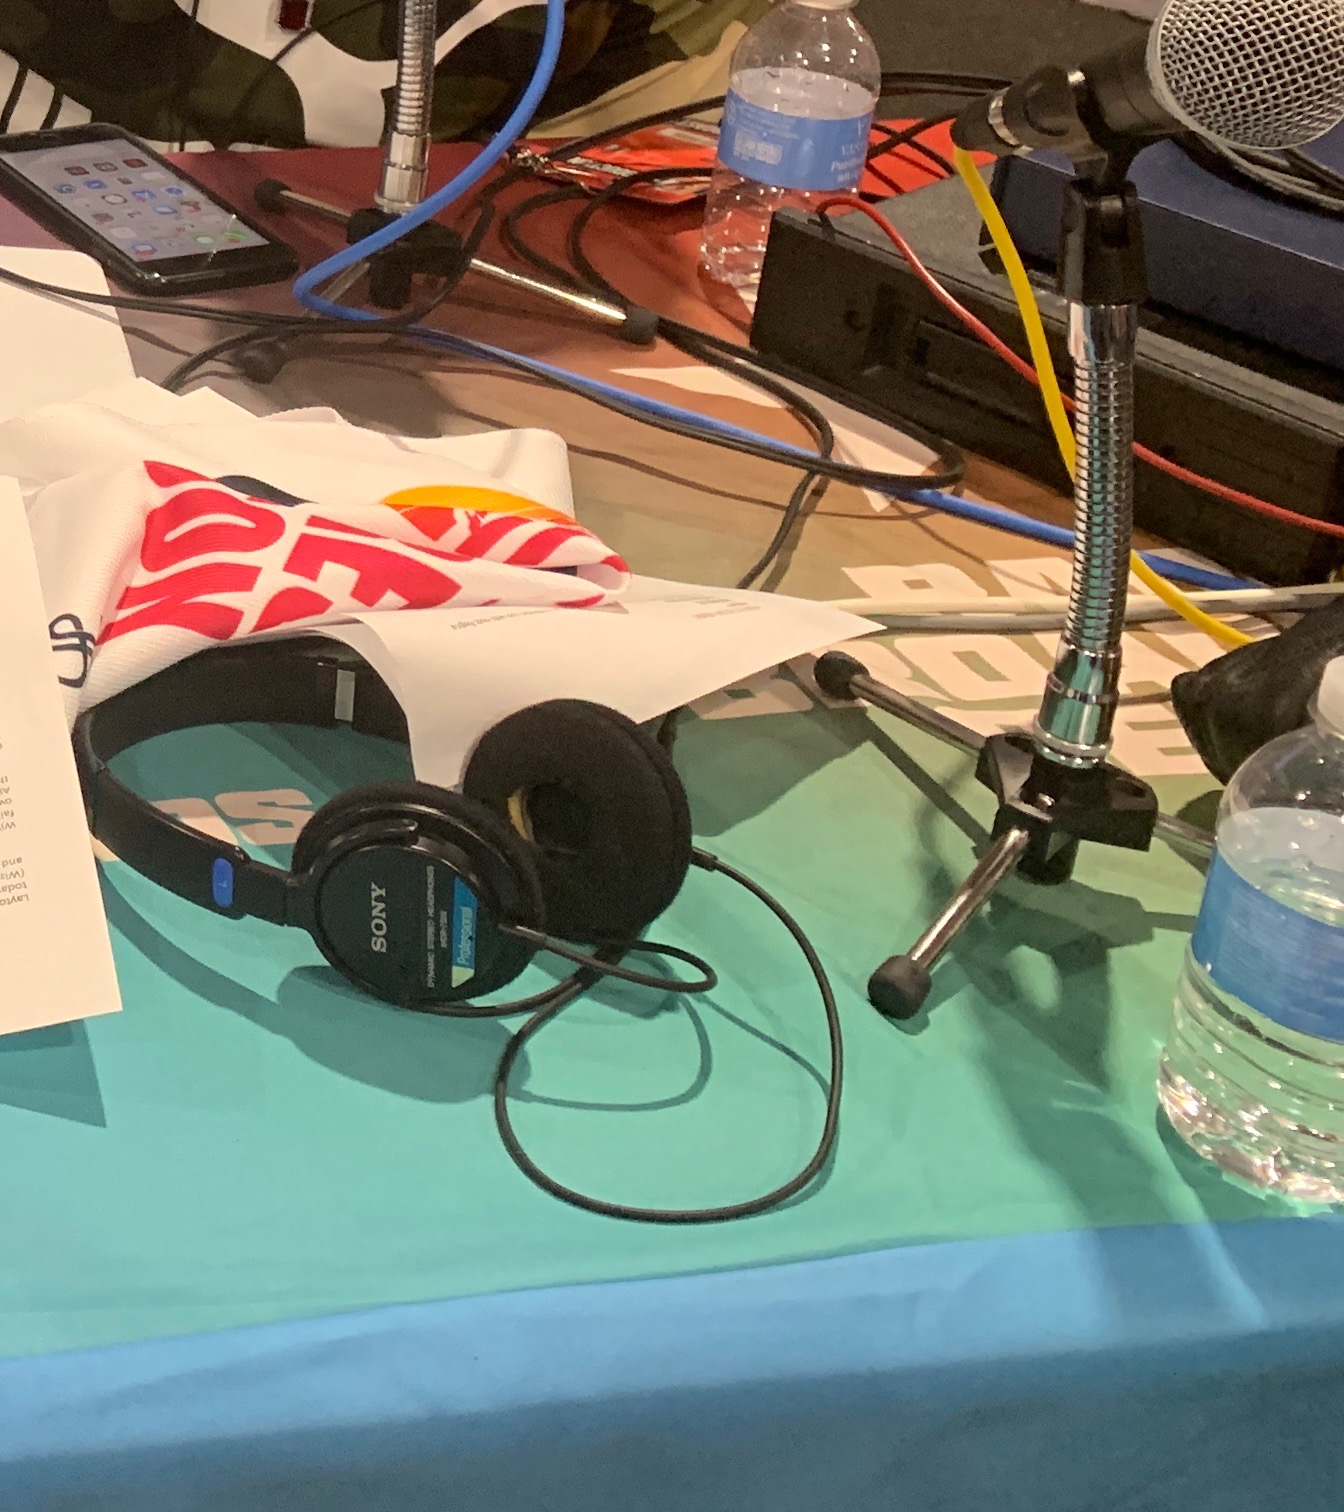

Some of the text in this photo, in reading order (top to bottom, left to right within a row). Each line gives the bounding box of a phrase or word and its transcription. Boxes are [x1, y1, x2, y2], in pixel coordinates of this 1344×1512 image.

[1, 857, 23, 868] and
[370, 881, 387, 953] SONY
[456, 906, 473, 966] Professional
